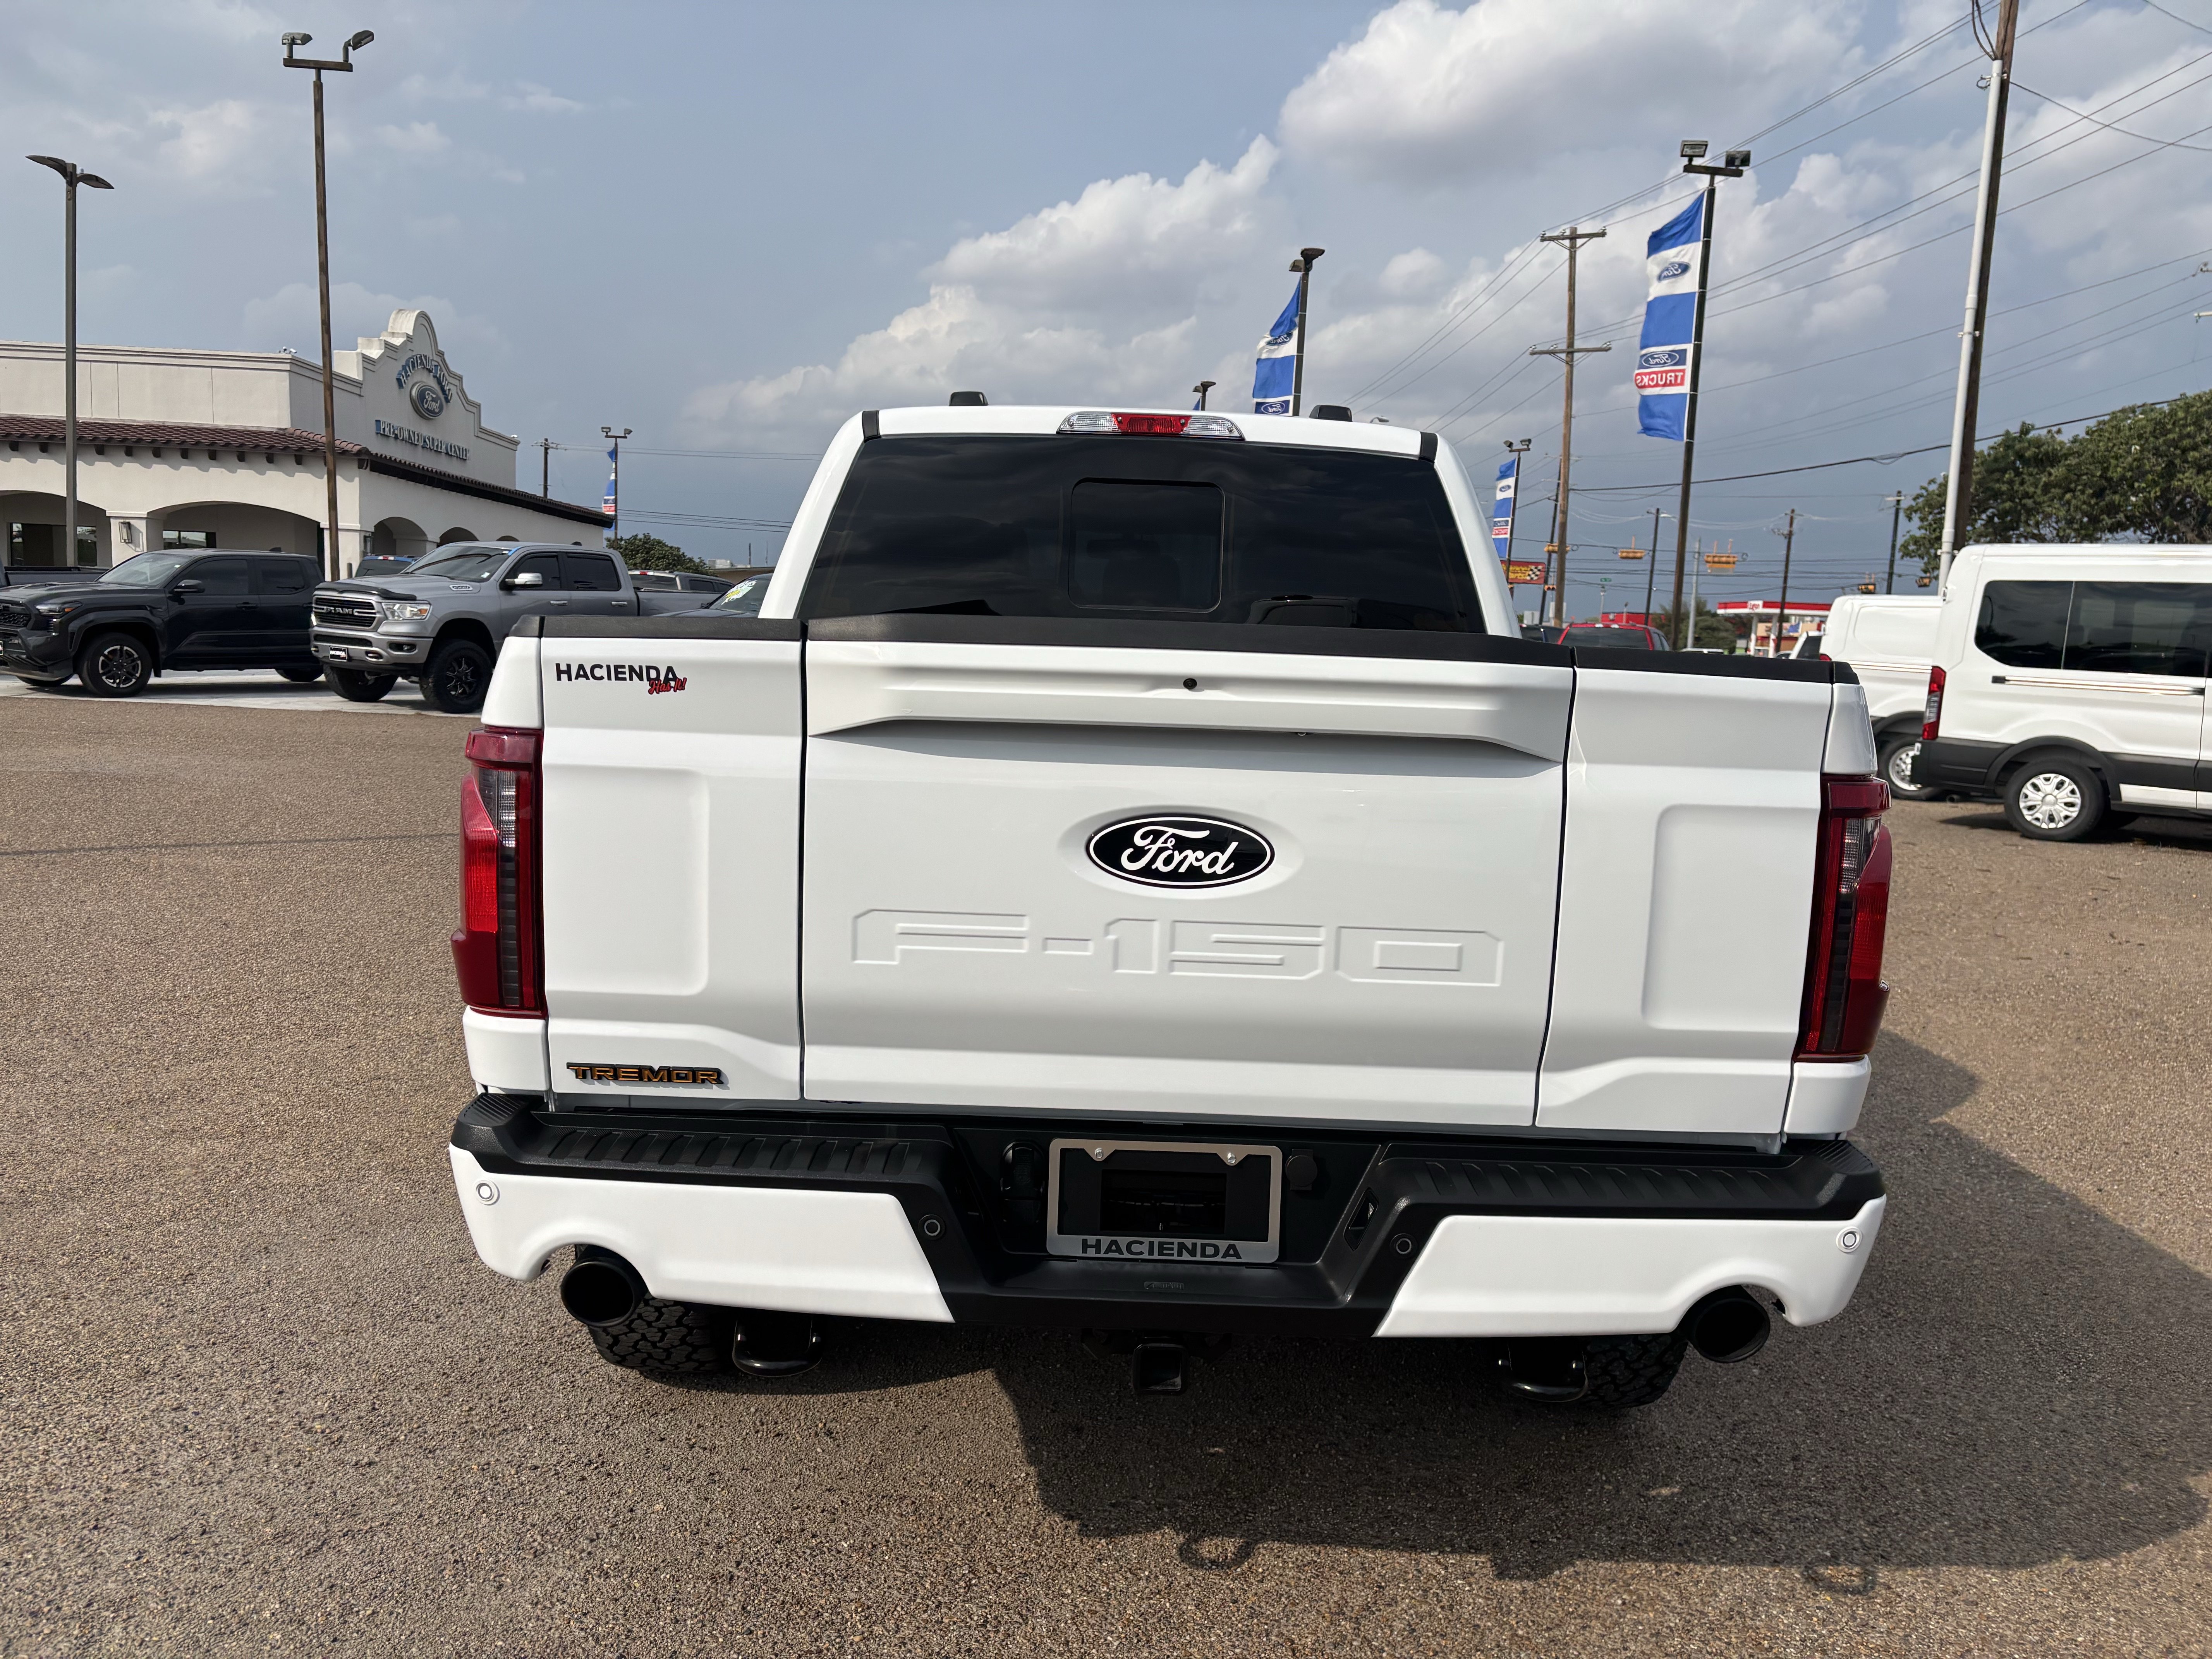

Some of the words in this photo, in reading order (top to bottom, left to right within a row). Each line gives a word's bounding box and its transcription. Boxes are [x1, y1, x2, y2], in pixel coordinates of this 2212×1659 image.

[397, 354, 435, 388] HACIENDA
[423, 391, 440, 412] Ford
[379, 420, 424, 446] PRE-OWNED
[425, 435, 447, 453] SUPER
[448, 442, 470, 460] CENTER
[555, 663, 678, 683] HACIENDA
[648, 679, 672, 695] Has
[673, 677, 687, 692] It!
[1121, 825, 1238, 875] Ford
[853, 909, 1504, 986] F-150
[566, 1062, 724, 1084] TREMOR
[1081, 1238, 1242, 1260] HACIENDA
